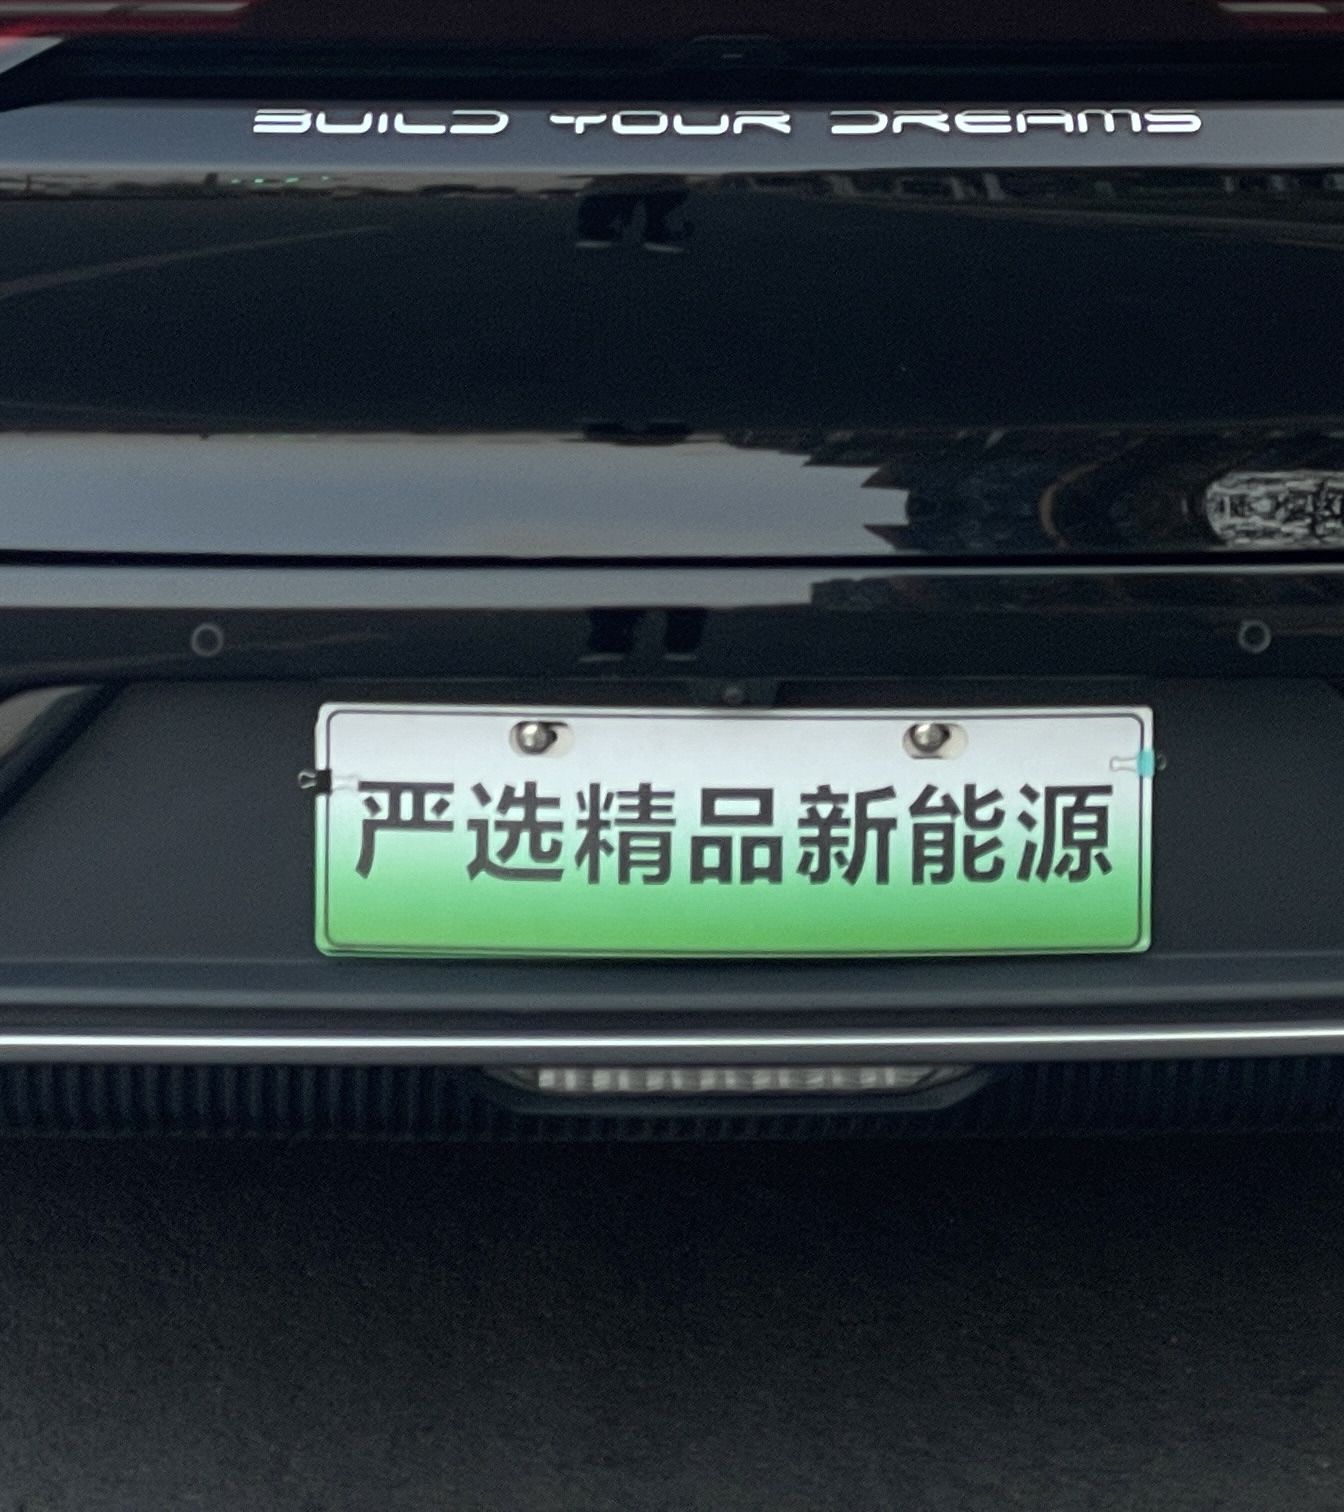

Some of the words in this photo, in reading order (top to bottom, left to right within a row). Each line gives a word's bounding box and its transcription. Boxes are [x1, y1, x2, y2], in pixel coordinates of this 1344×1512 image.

[253, 108, 509, 135] BUILD
[549, 110, 792, 135] YOUR
[830, 109, 1203, 134] DREAMS
[354, 780, 1115, 887] 严选精品新能源
